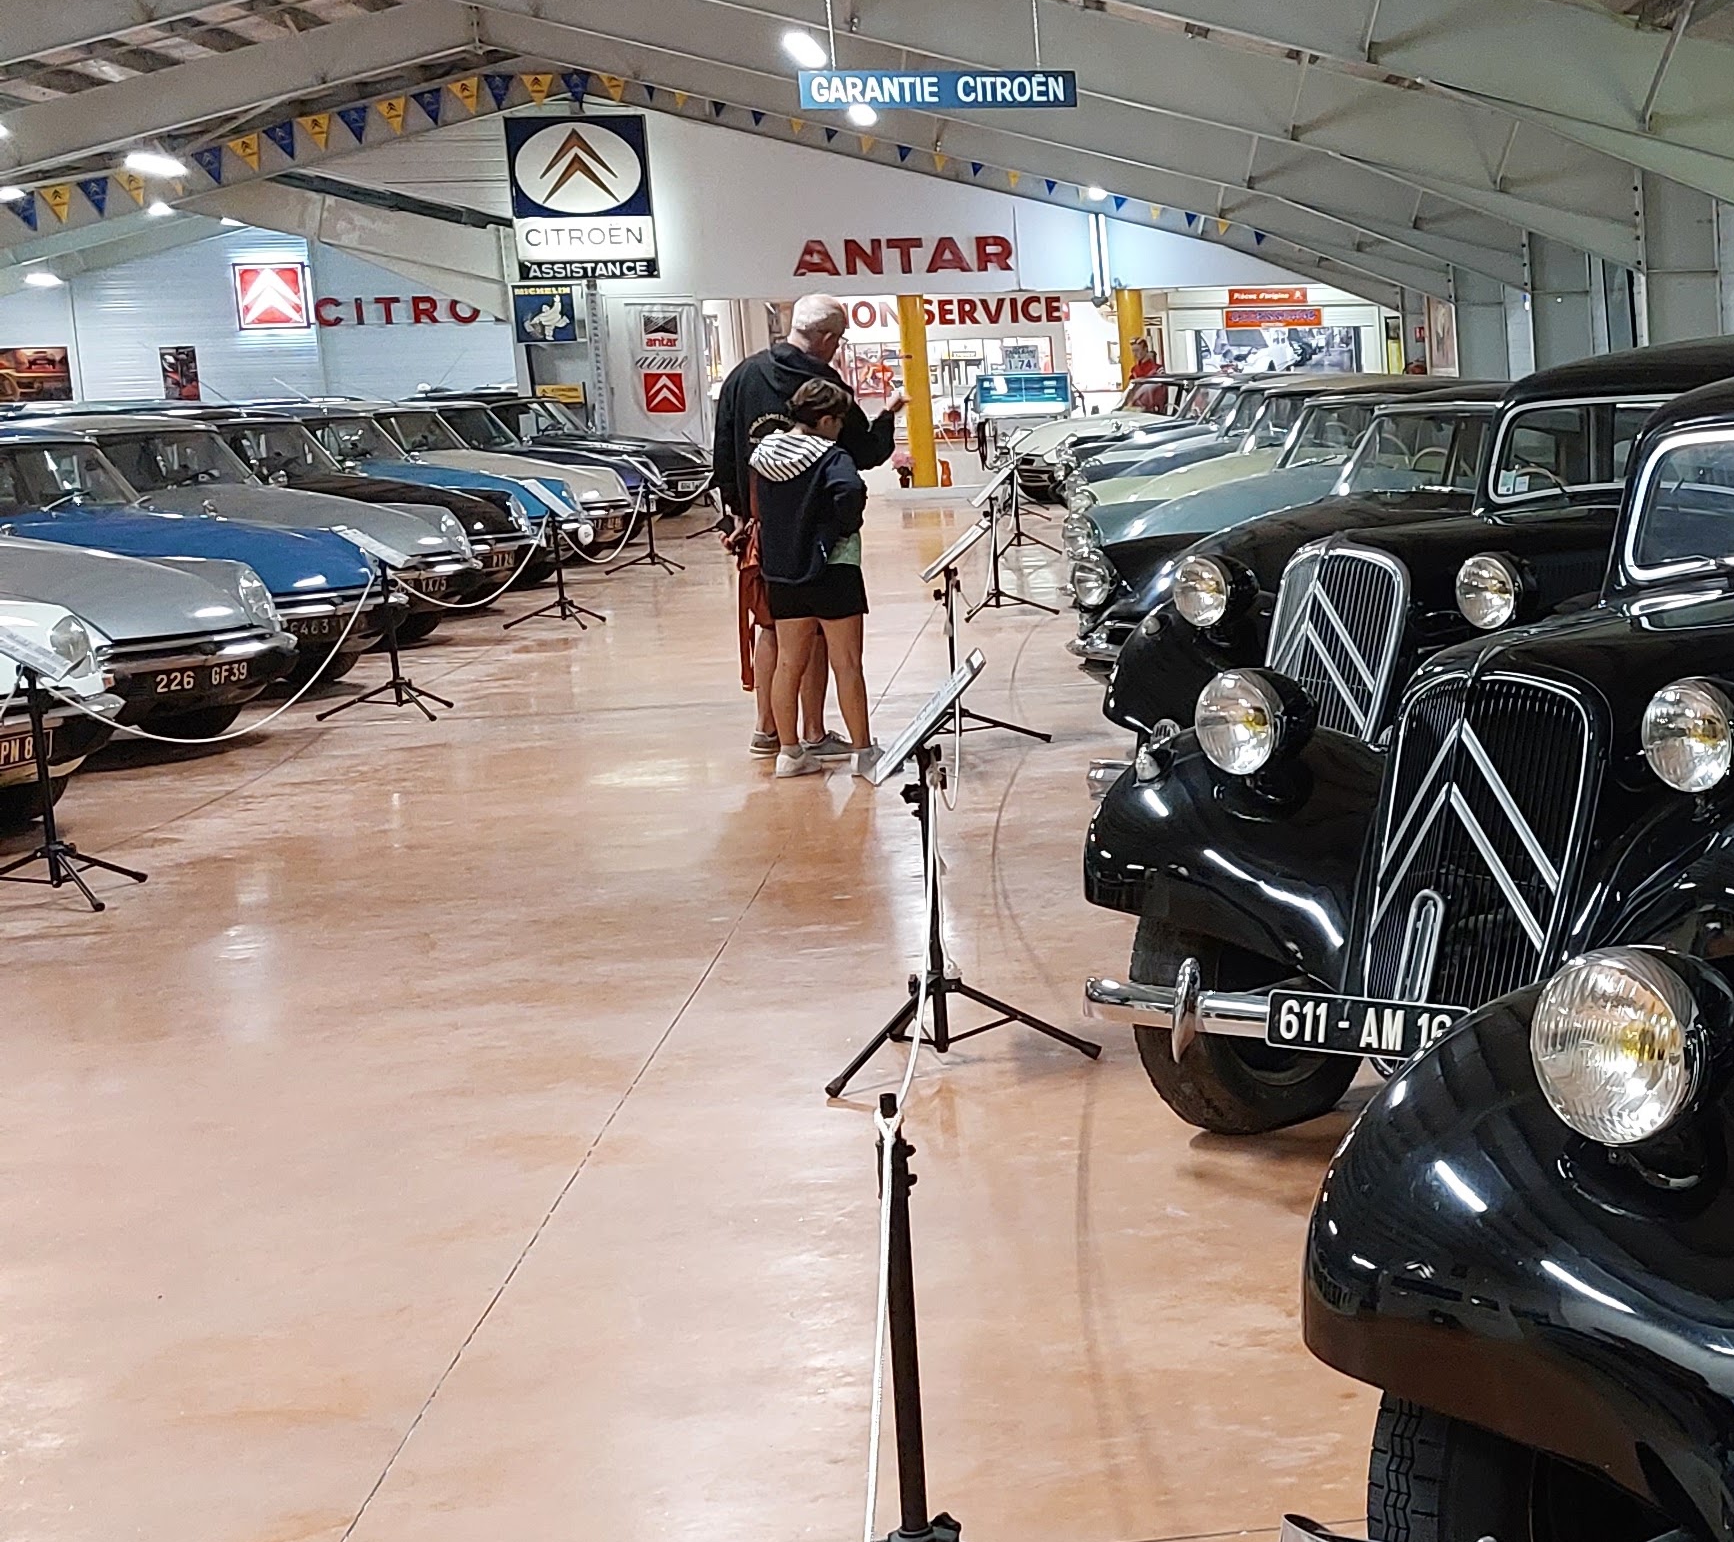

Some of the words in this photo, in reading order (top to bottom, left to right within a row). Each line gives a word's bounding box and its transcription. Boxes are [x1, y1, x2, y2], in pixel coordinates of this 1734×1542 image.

[810, 75, 939, 103] GARANTIE
[956, 73, 1065, 102] CITROËN
[525, 223, 643, 247] CITROËN
[793, 235, 1015, 276] ANTAR
[529, 261, 649, 278] ASSISTANCE
[645, 336, 679, 348] antar
[635, 352, 688, 370] aime
[156, 671, 195, 693] 226
[211, 661, 248, 685] GF39
[1279, 999, 1328, 1044] 611
[1359, 1007, 1406, 1051] AM
